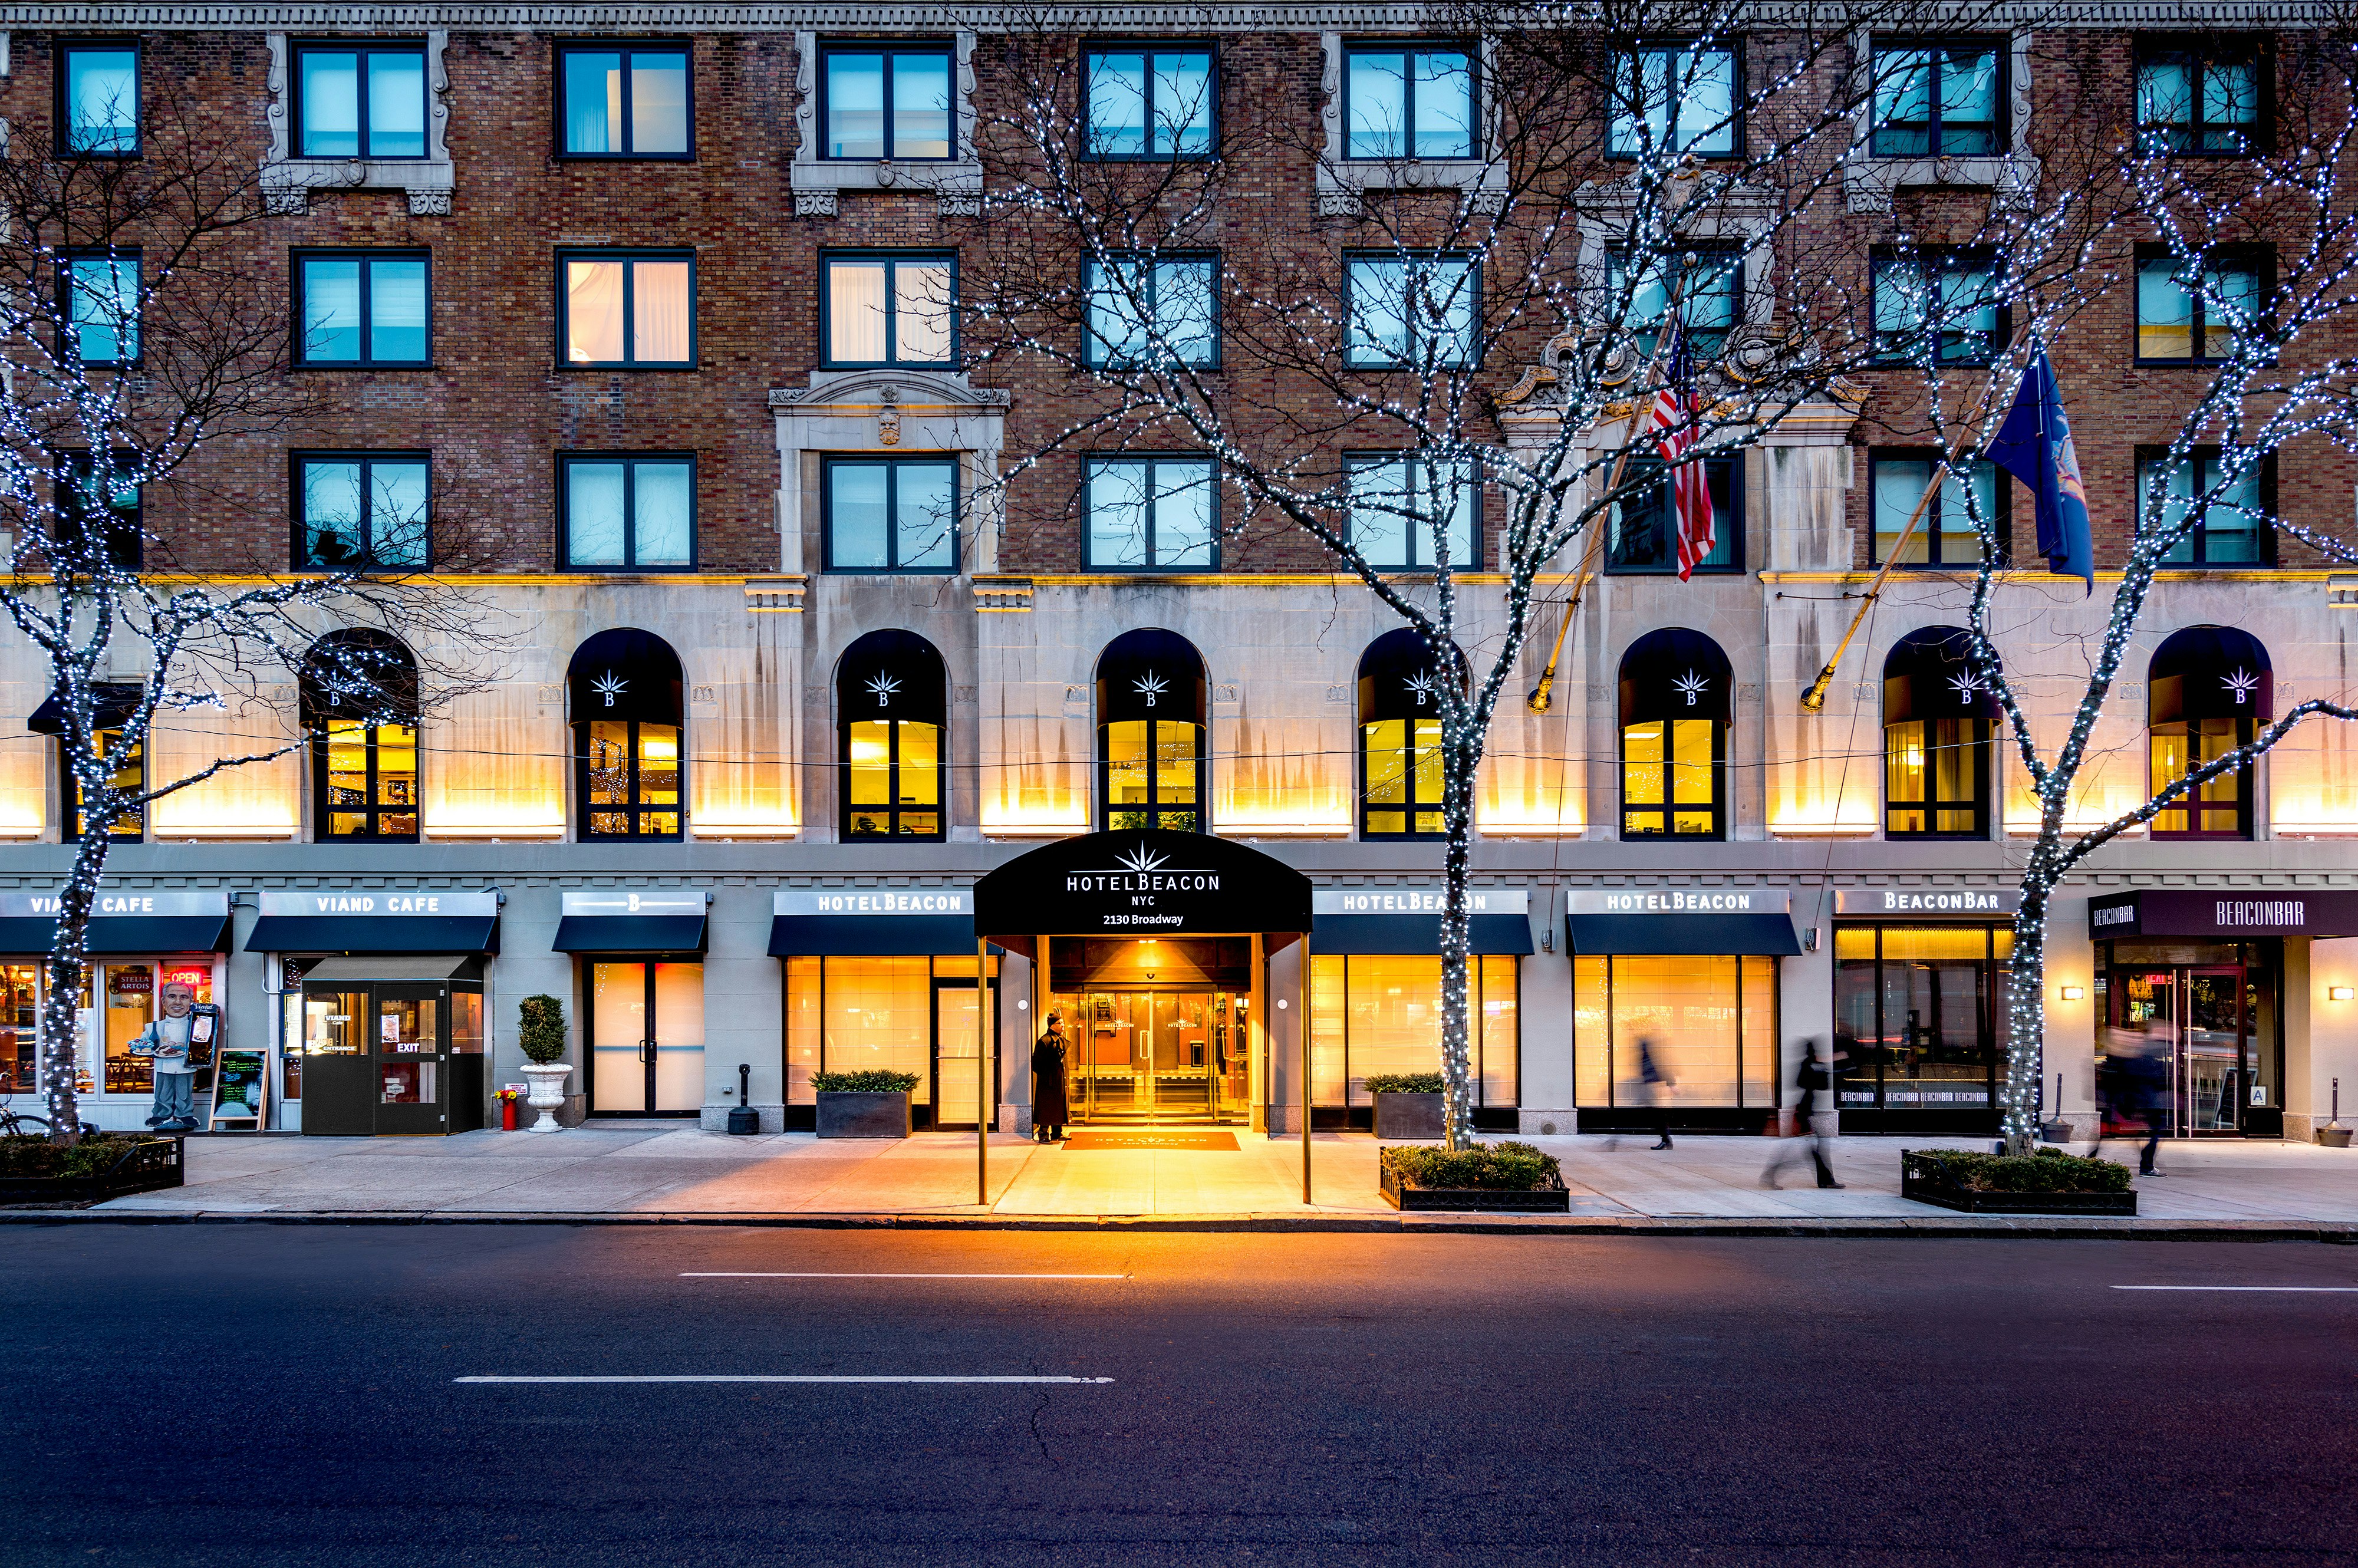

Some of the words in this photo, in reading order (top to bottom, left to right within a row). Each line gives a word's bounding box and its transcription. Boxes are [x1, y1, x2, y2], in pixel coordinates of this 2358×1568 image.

[331, 691, 340, 706] B
[605, 692, 614, 706] B
[879, 692, 888, 706] B
[1147, 692, 1155, 706] B
[1417, 690, 1426, 704] B
[1687, 691, 1696, 705] B
[1962, 690, 1971, 704] B
[2236, 689, 2245, 703] B
[102, 897, 153, 912] CAFE
[317, 897, 374, 912] VIAND
[388, 897, 439, 912] CAFE
[628, 894, 641, 911] B
[1132, 896, 1155, 906] NYC
[1344, 892, 1486, 910] HOTELBEAON
[1104, 915, 1129, 924] 2130
[1132, 914, 1184, 926] Broadway
[2094, 905, 2133, 926] BEACONBAR
[2217, 901, 2304, 925] BEACONBAR
[172, 973, 199, 983] OPEN
[397, 1043, 420, 1052] EXIT
[1841, 1092, 1874, 1102] BEACONBAR
[1885, 1092, 1919, 1102] BEACONBAR
[1920, 1092, 1953, 1102] BEACONBAR
[1955, 1092, 1988, 1102] BEACONBAR
[2253, 1090, 2263, 1101] A
